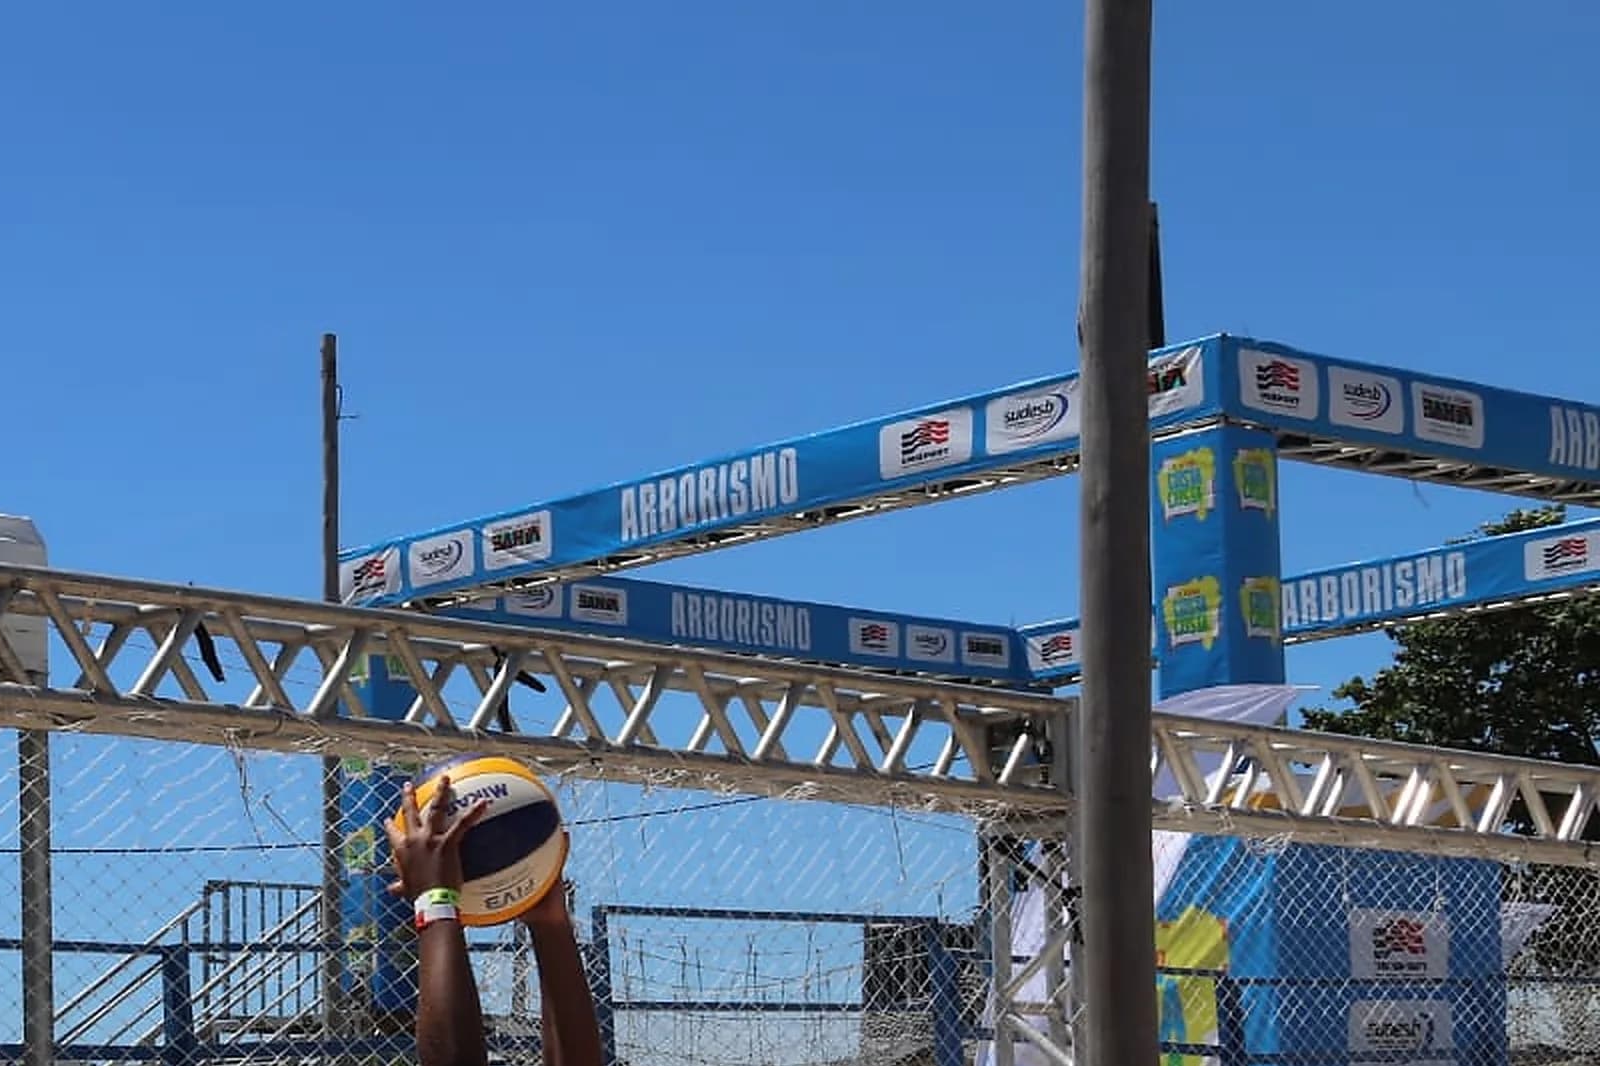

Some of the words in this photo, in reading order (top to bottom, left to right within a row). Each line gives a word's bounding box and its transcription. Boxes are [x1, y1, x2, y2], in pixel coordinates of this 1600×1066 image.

[621, 447, 798, 542] ARBORISMO
[671, 591, 811, 651] ARBORISMO
[1281, 551, 1467, 631] ARBORISMO
